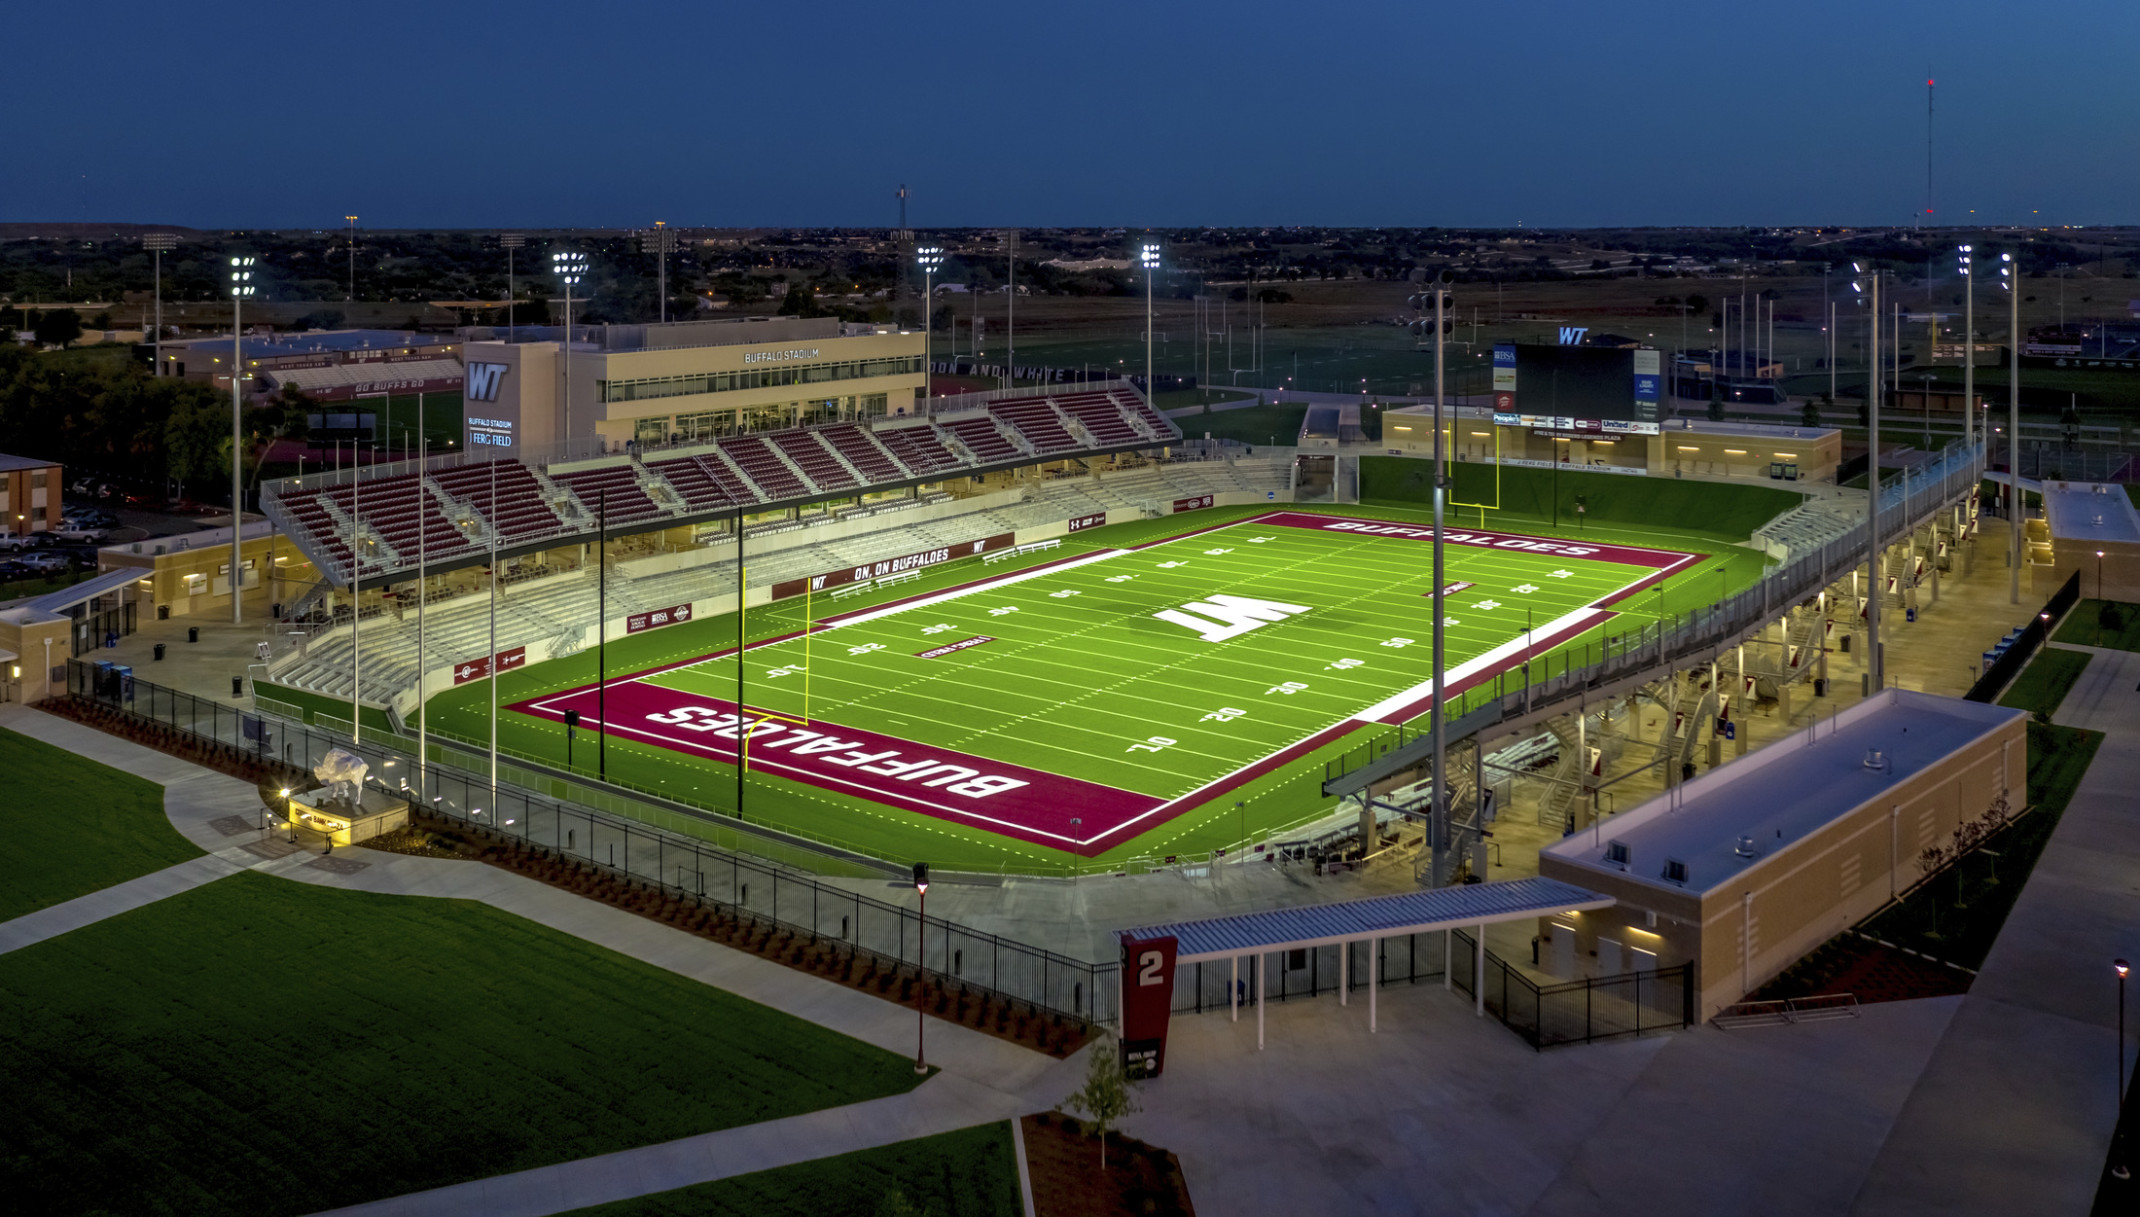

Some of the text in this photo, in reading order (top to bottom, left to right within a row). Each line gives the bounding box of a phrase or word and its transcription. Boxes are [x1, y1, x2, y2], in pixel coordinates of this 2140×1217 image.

[1559, 326, 1588, 345] WT
[744, 348, 819, 363] BUFFALO STADIUM
[969, 364, 1000, 377] AND
[1013, 365, 1065, 381] WHITE
[355, 379, 425, 393] GO BUFFS GO
[467, 362, 508, 401] WT
[468, 417, 512, 428] BUFFALO STADIUM
[1603, 420, 1628, 429] United
[473, 433, 491, 445] FERG
[492, 435, 512, 447] FIELD
[1323, 521, 1600, 556] BUFFALOES
[812, 540, 986, 591] WT ON, ON BUFFALOES WT
[1152, 594, 1313, 643] WT
[848, 642, 882, 656] 20
[1380, 637, 1415, 648] 50
[1330, 658, 1365, 669] 40
[766, 664, 804, 679] 10
[1271, 681, 1309, 695] 30
[1206, 707, 1247, 722] 20
[646, 705, 1030, 798] BUFFALOES
[1131, 736, 1177, 752] 10
[1139, 950, 1164, 987] 2
